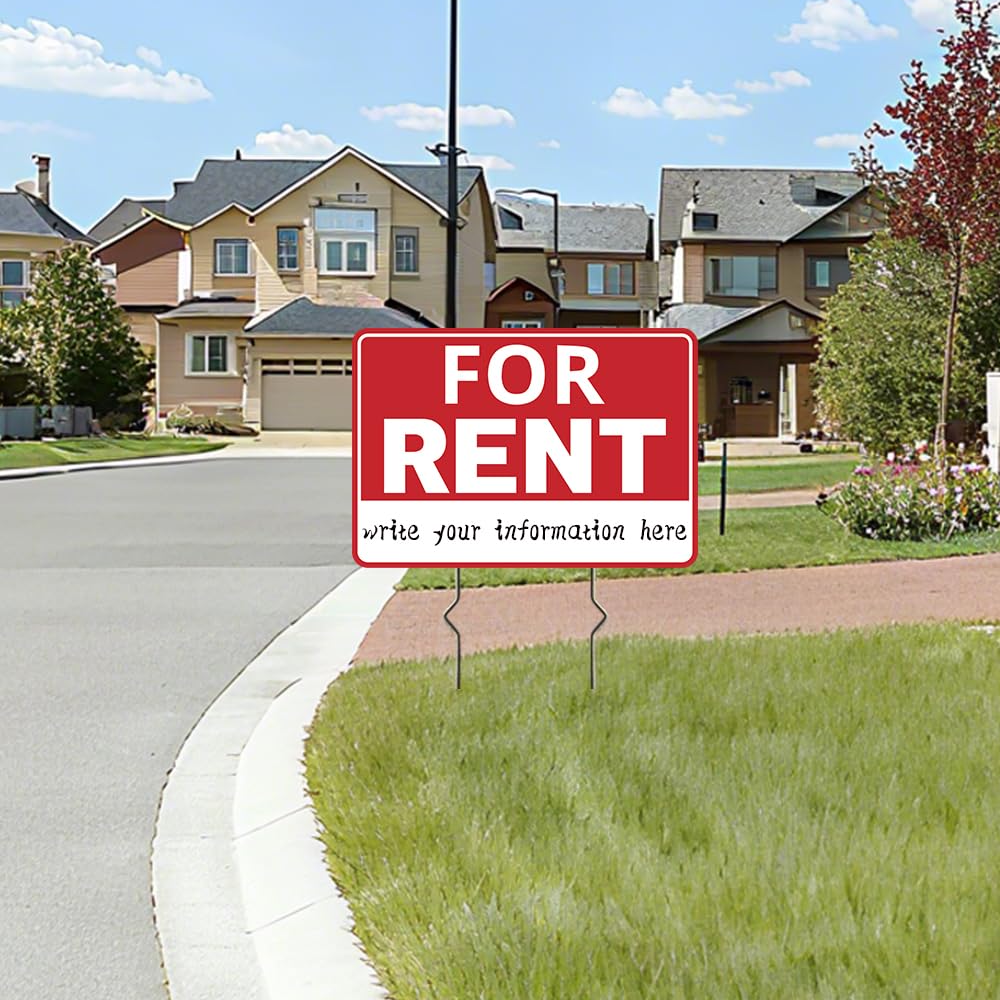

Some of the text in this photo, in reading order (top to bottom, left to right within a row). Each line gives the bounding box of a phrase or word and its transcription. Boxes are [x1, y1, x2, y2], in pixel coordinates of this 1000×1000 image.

[444, 344, 605, 406] FOR
[383, 418, 667, 494] RENT
[363, 518, 687, 547] write your information here
